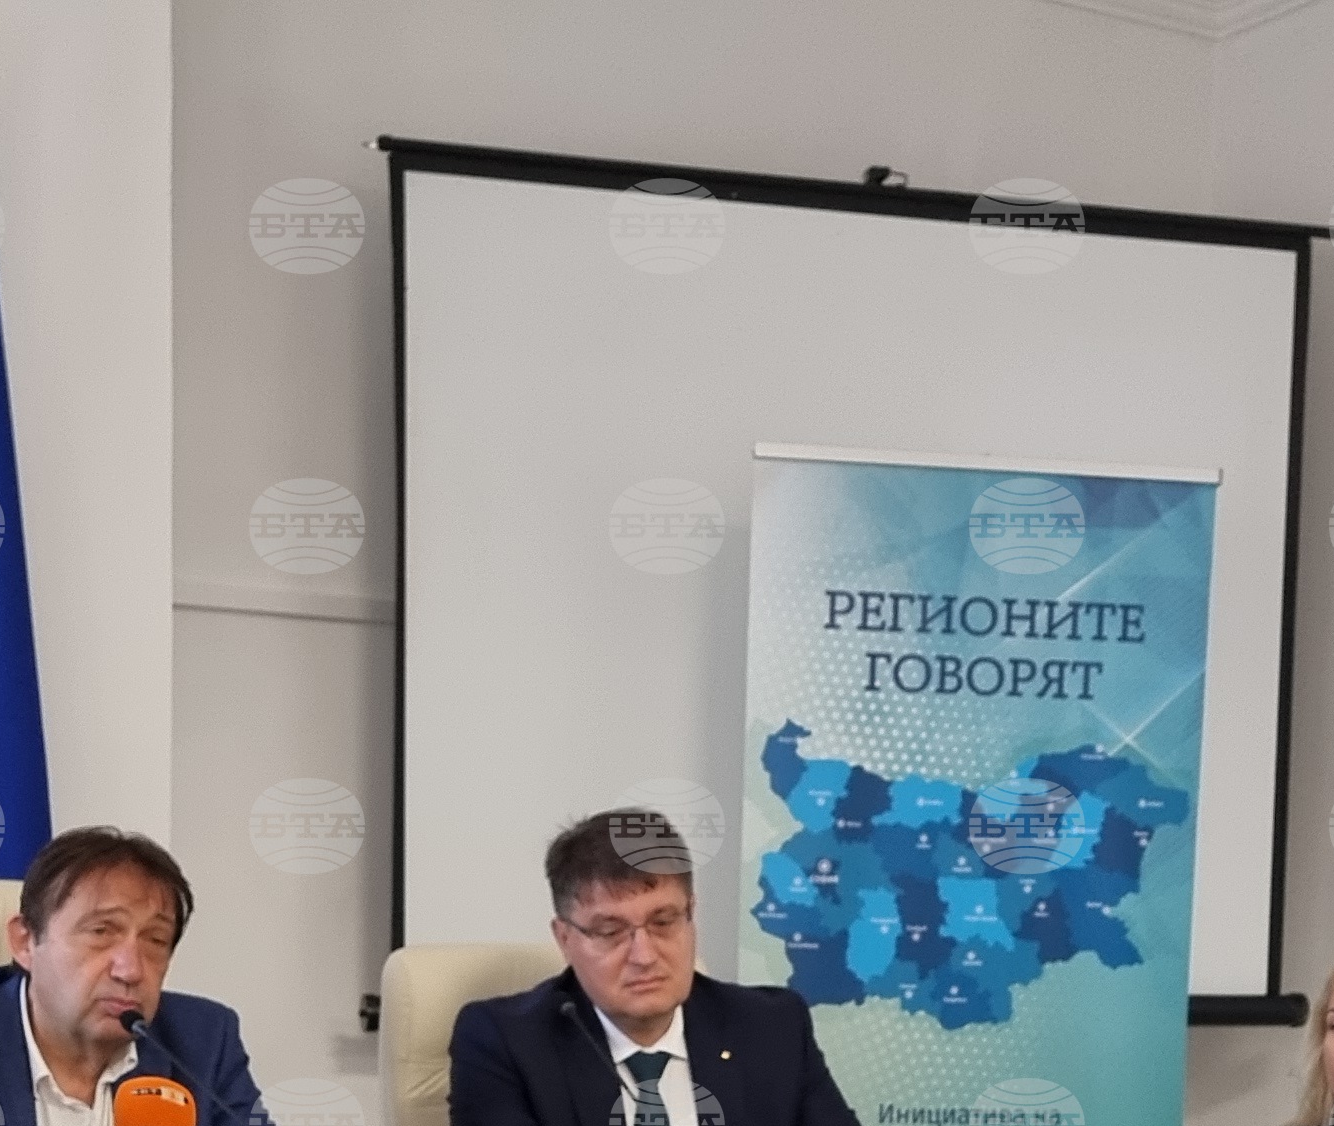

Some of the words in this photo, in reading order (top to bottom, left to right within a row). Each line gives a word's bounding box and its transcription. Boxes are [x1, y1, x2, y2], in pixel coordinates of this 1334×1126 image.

[824, 590, 1146, 644] РЕГИОНИТЕ
[864, 652, 1104, 700] ГОВОРЯТ
[1033, 1107, 1061, 1125] на
